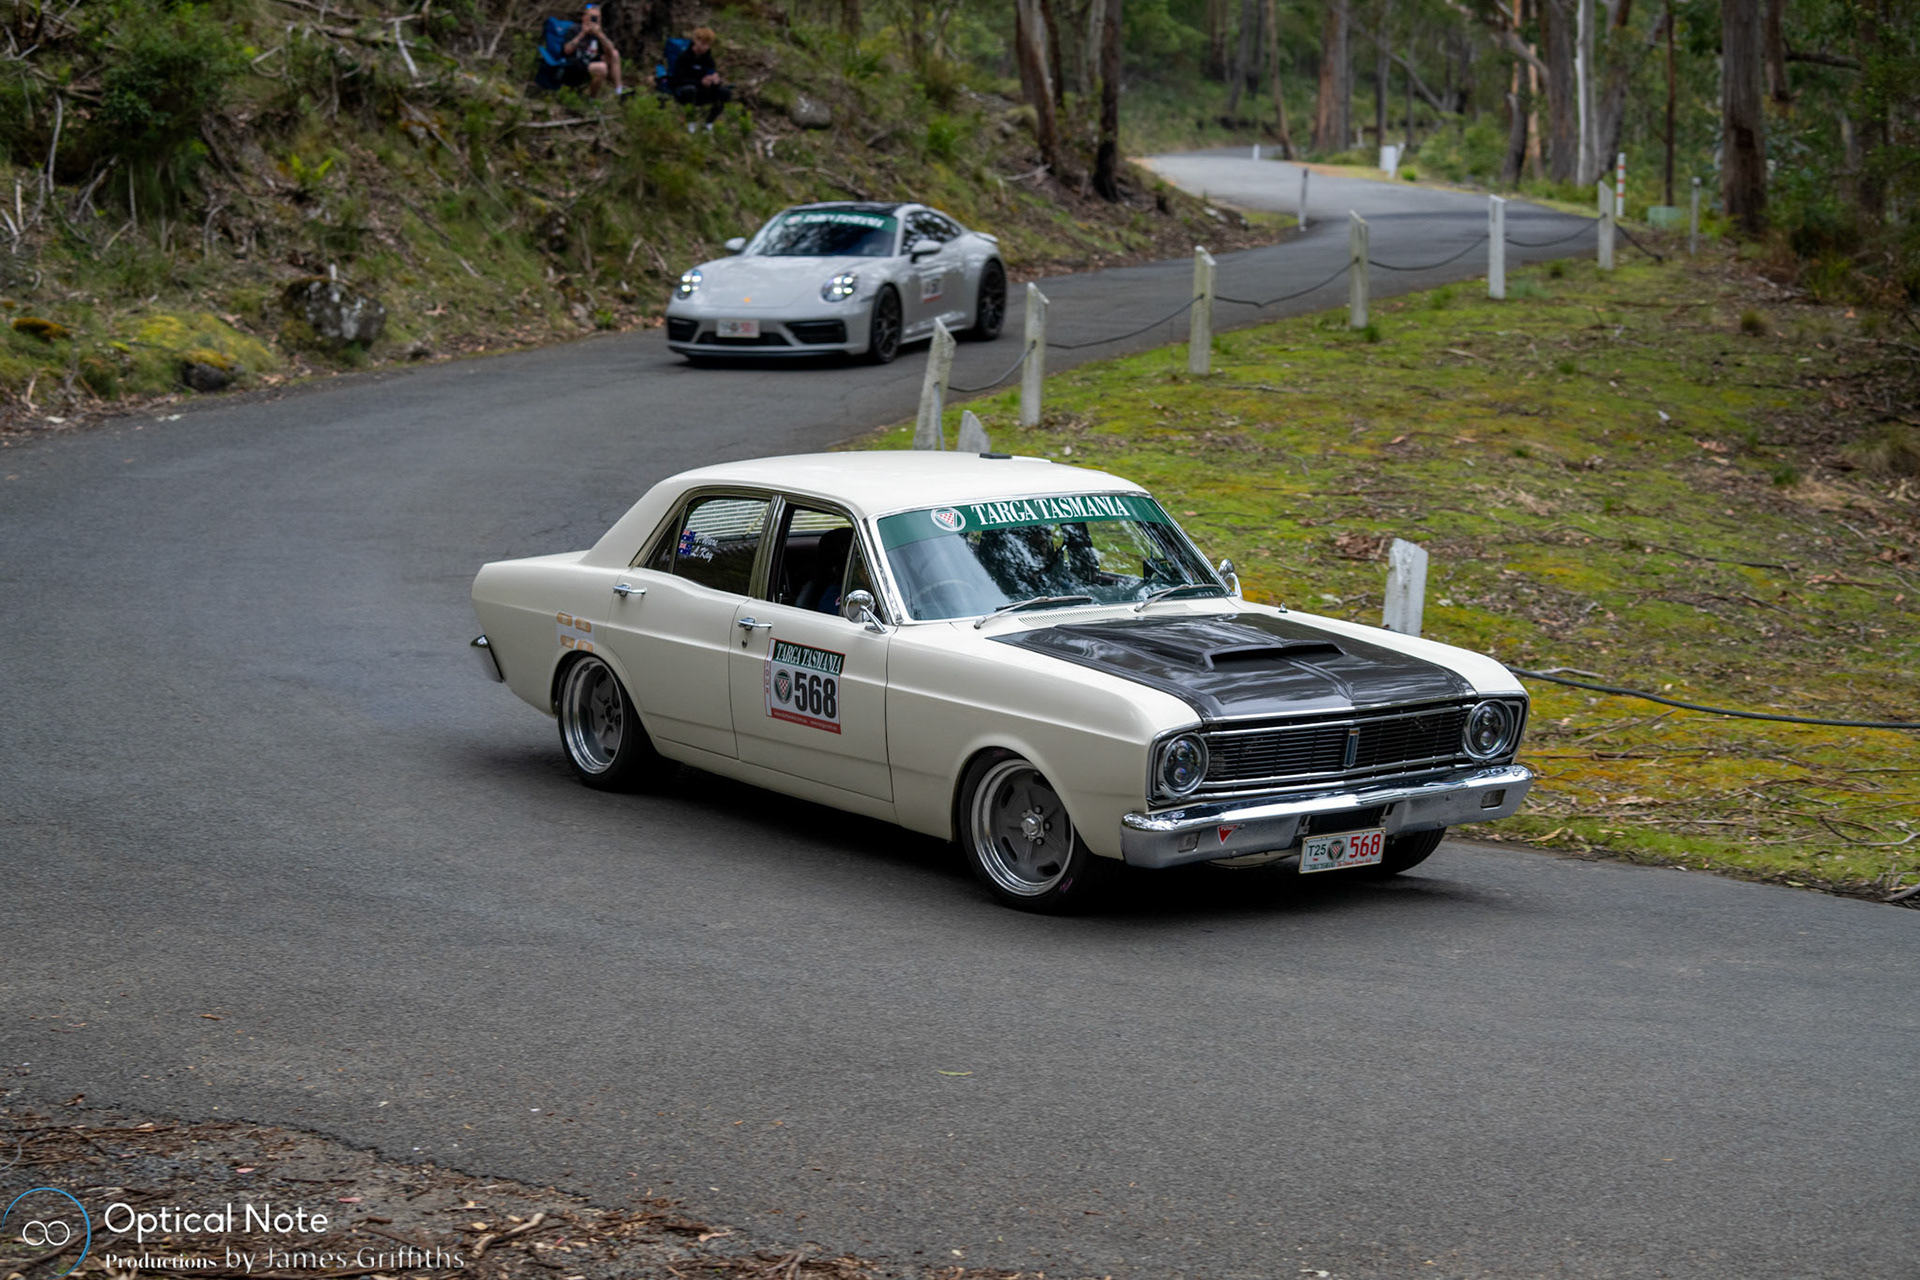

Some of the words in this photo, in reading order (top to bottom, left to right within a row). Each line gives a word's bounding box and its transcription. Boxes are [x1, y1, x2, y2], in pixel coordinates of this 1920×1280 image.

[970, 501, 1040, 526] TARGA
[1034, 496, 1131, 519] TASMANIA
[776, 643, 803, 665] TARGA
[801, 649, 842, 674] TASMANIA
[794, 671, 837, 719] 568
[1308, 844, 1327, 857] T25
[1349, 833, 1382, 858] 568
